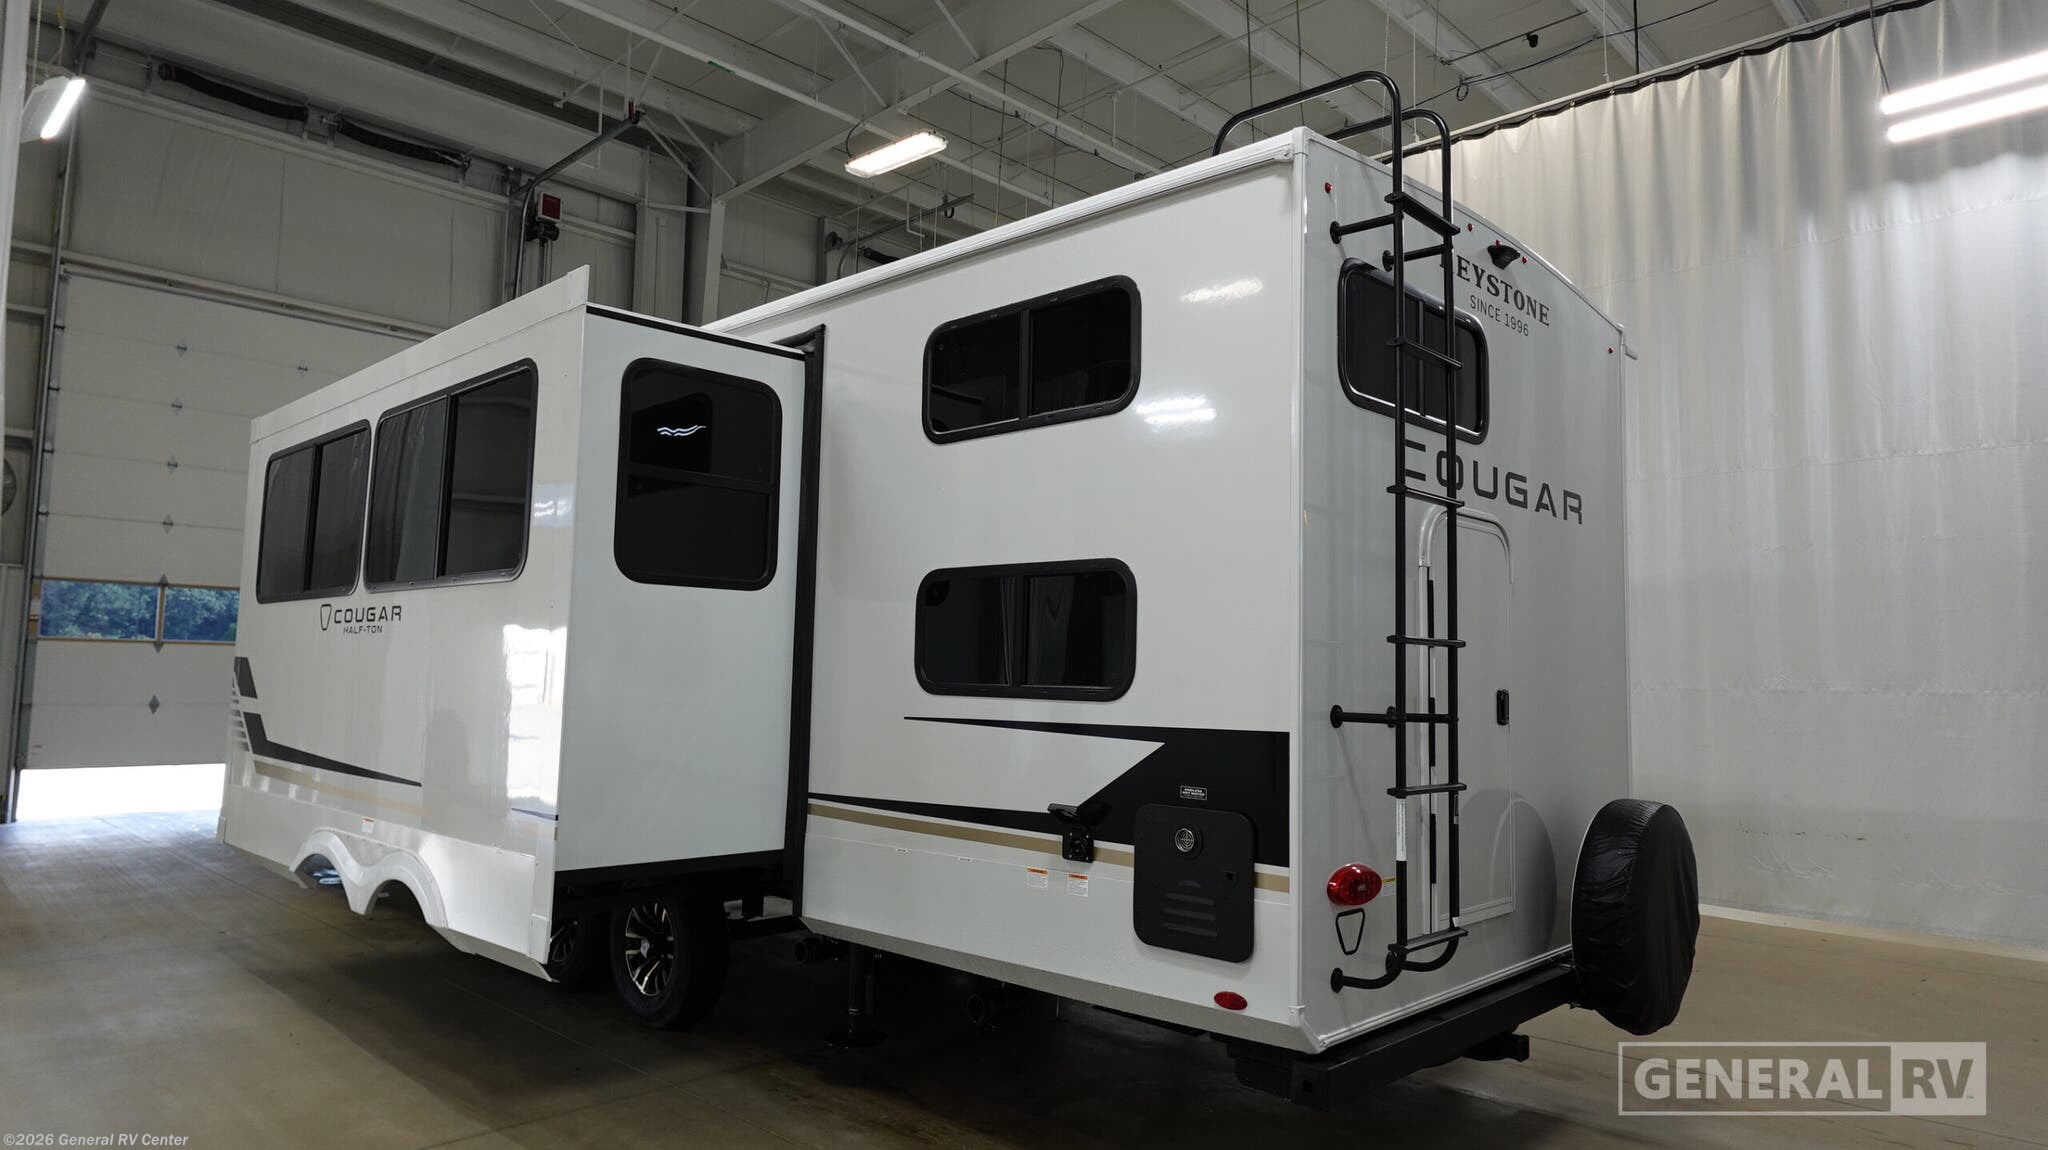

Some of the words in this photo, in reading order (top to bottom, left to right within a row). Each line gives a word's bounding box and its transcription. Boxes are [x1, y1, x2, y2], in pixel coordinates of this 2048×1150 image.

[1440, 253, 1550, 327] EYSTONE
[1470, 294, 1501, 323] SINCE
[1505, 313, 1530, 337] 1996
[334, 605, 402, 624] COUGAR
[343, 625, 383, 635] HALF-TON
